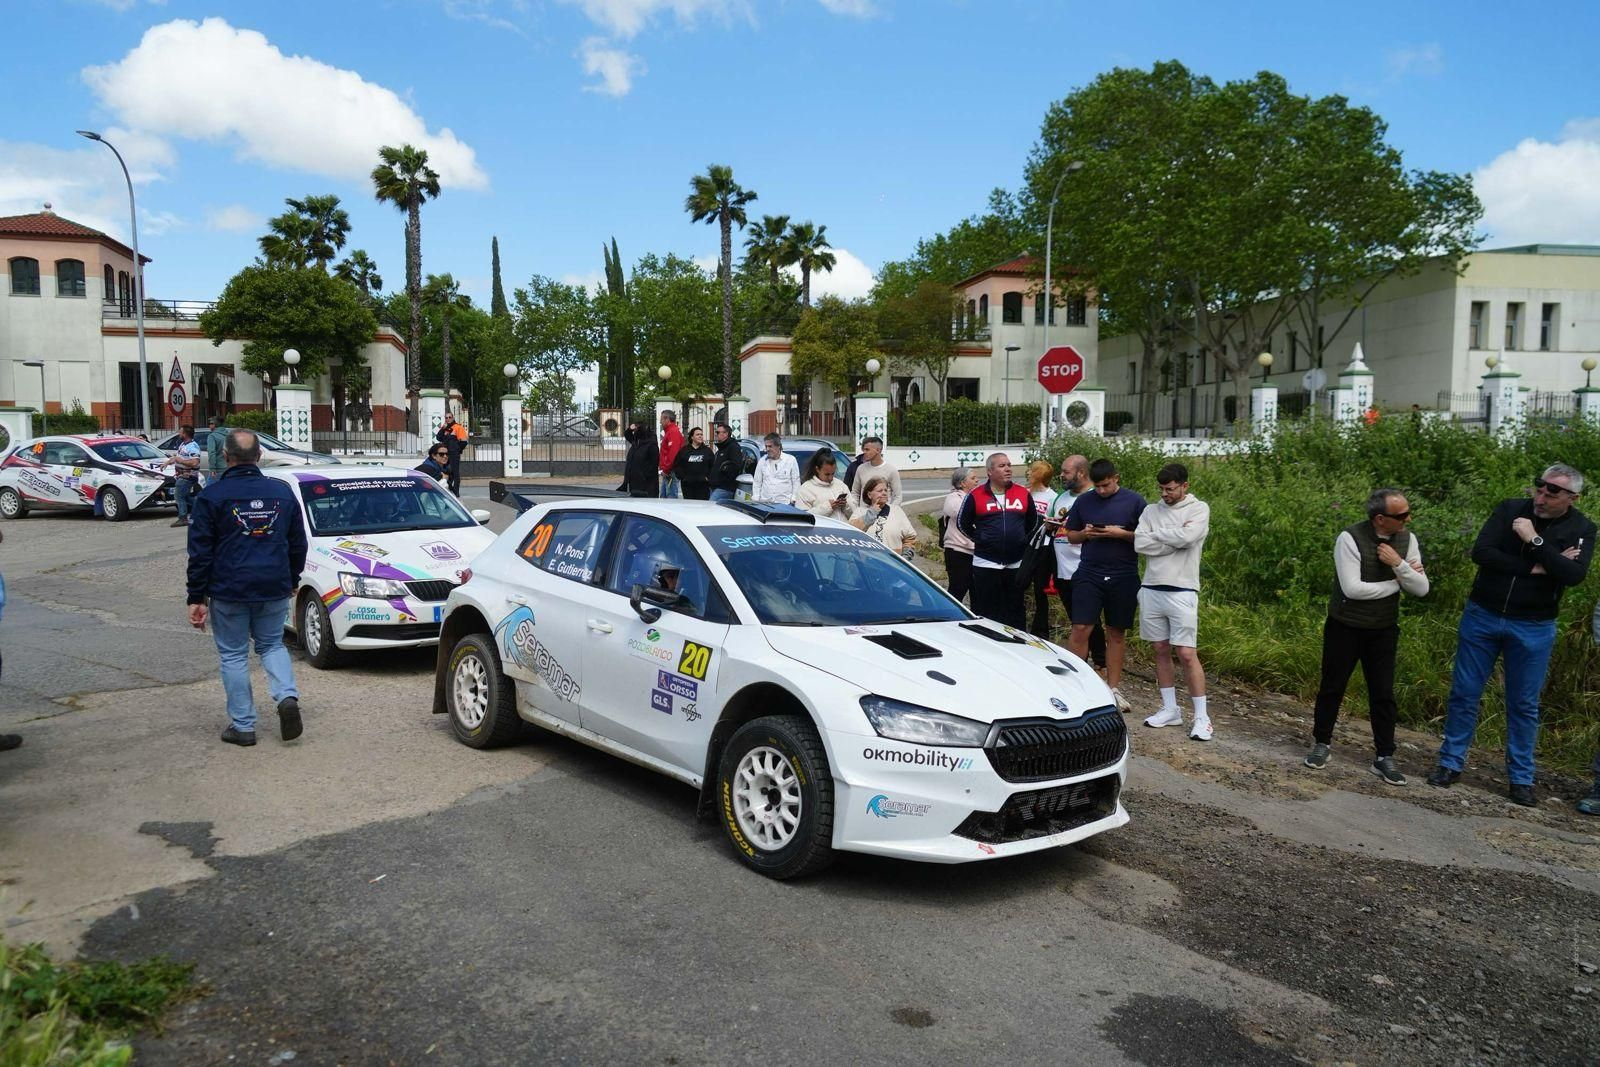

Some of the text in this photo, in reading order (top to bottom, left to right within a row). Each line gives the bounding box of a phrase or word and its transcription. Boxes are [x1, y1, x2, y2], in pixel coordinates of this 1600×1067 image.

[1041, 363, 1080, 377] STOP
[172, 394, 183, 406] 30
[523, 524, 553, 559] 20
[721, 533, 886, 550] Seramarhotels.com
[555, 543, 585, 560] N. Pons
[548, 559, 556, 571] E.
[512, 619, 581, 703] Seramar
[680, 644, 707, 678] 20
[670, 683, 696, 699] ORSSO
[863, 748, 959, 771] okmobility
[722, 780, 756, 857] SCORPION
